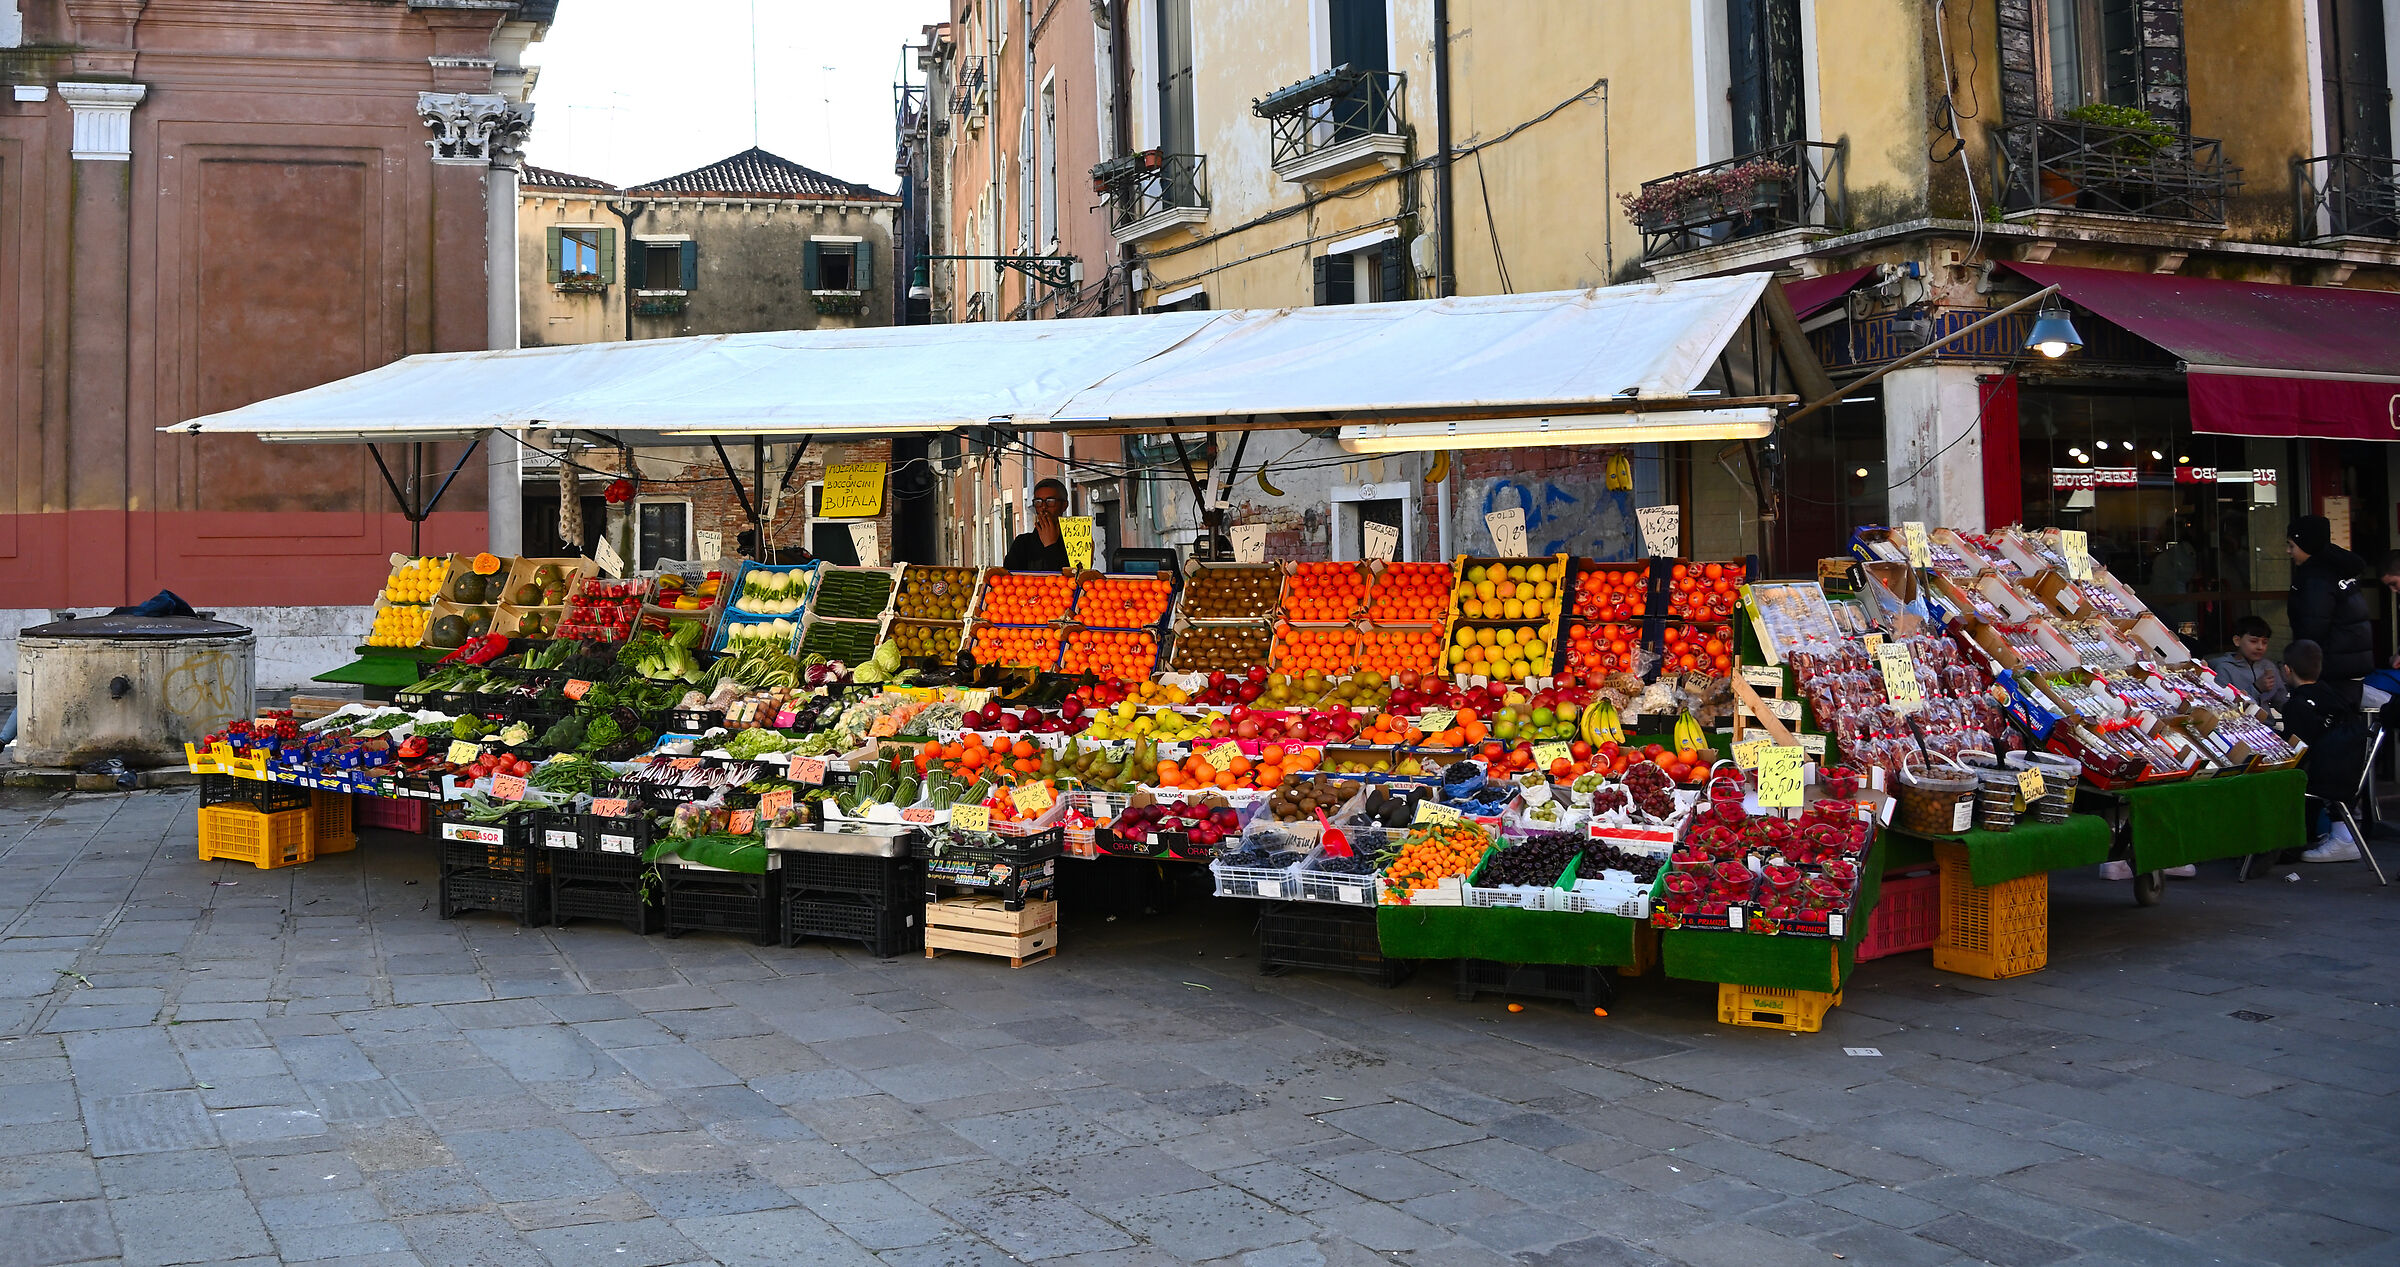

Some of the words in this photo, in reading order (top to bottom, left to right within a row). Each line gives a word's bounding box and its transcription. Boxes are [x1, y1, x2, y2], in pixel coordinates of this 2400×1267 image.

[829, 463, 879, 473] MOZZARELLE
[827, 480, 875, 489] BOCCONCINI
[825, 495, 878, 510] BUFALA
[1487, 510, 1516, 522] GOLD
[1760, 747, 1797, 755] FRAGOLE
[461, 829, 499, 842] VILLASOR
[1795, 925, 1828, 934] PRIMIZIE
